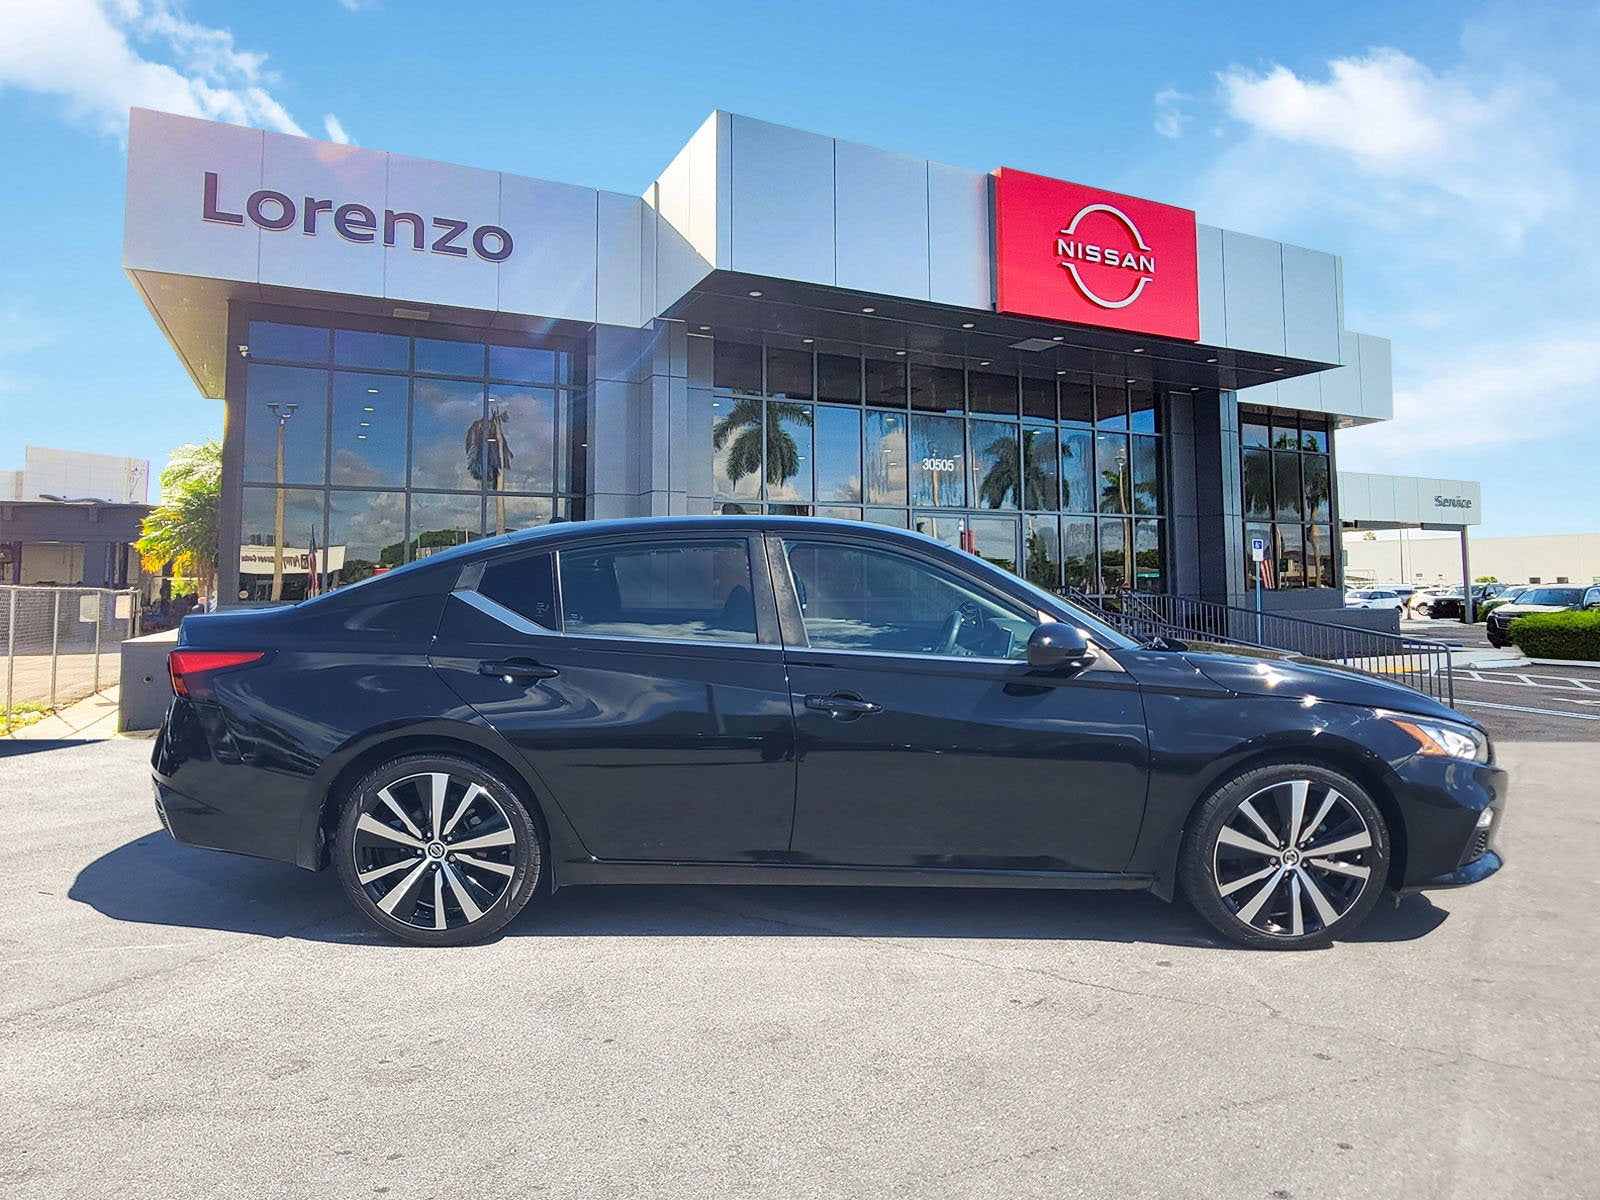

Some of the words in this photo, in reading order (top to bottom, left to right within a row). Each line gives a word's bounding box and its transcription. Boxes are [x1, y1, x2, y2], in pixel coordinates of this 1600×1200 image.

[202, 171, 514, 262] Lorenzo
[1057, 238, 1155, 273] NISSAN
[922, 457, 955, 472] 30505
[1434, 495, 1472, 509] Service
